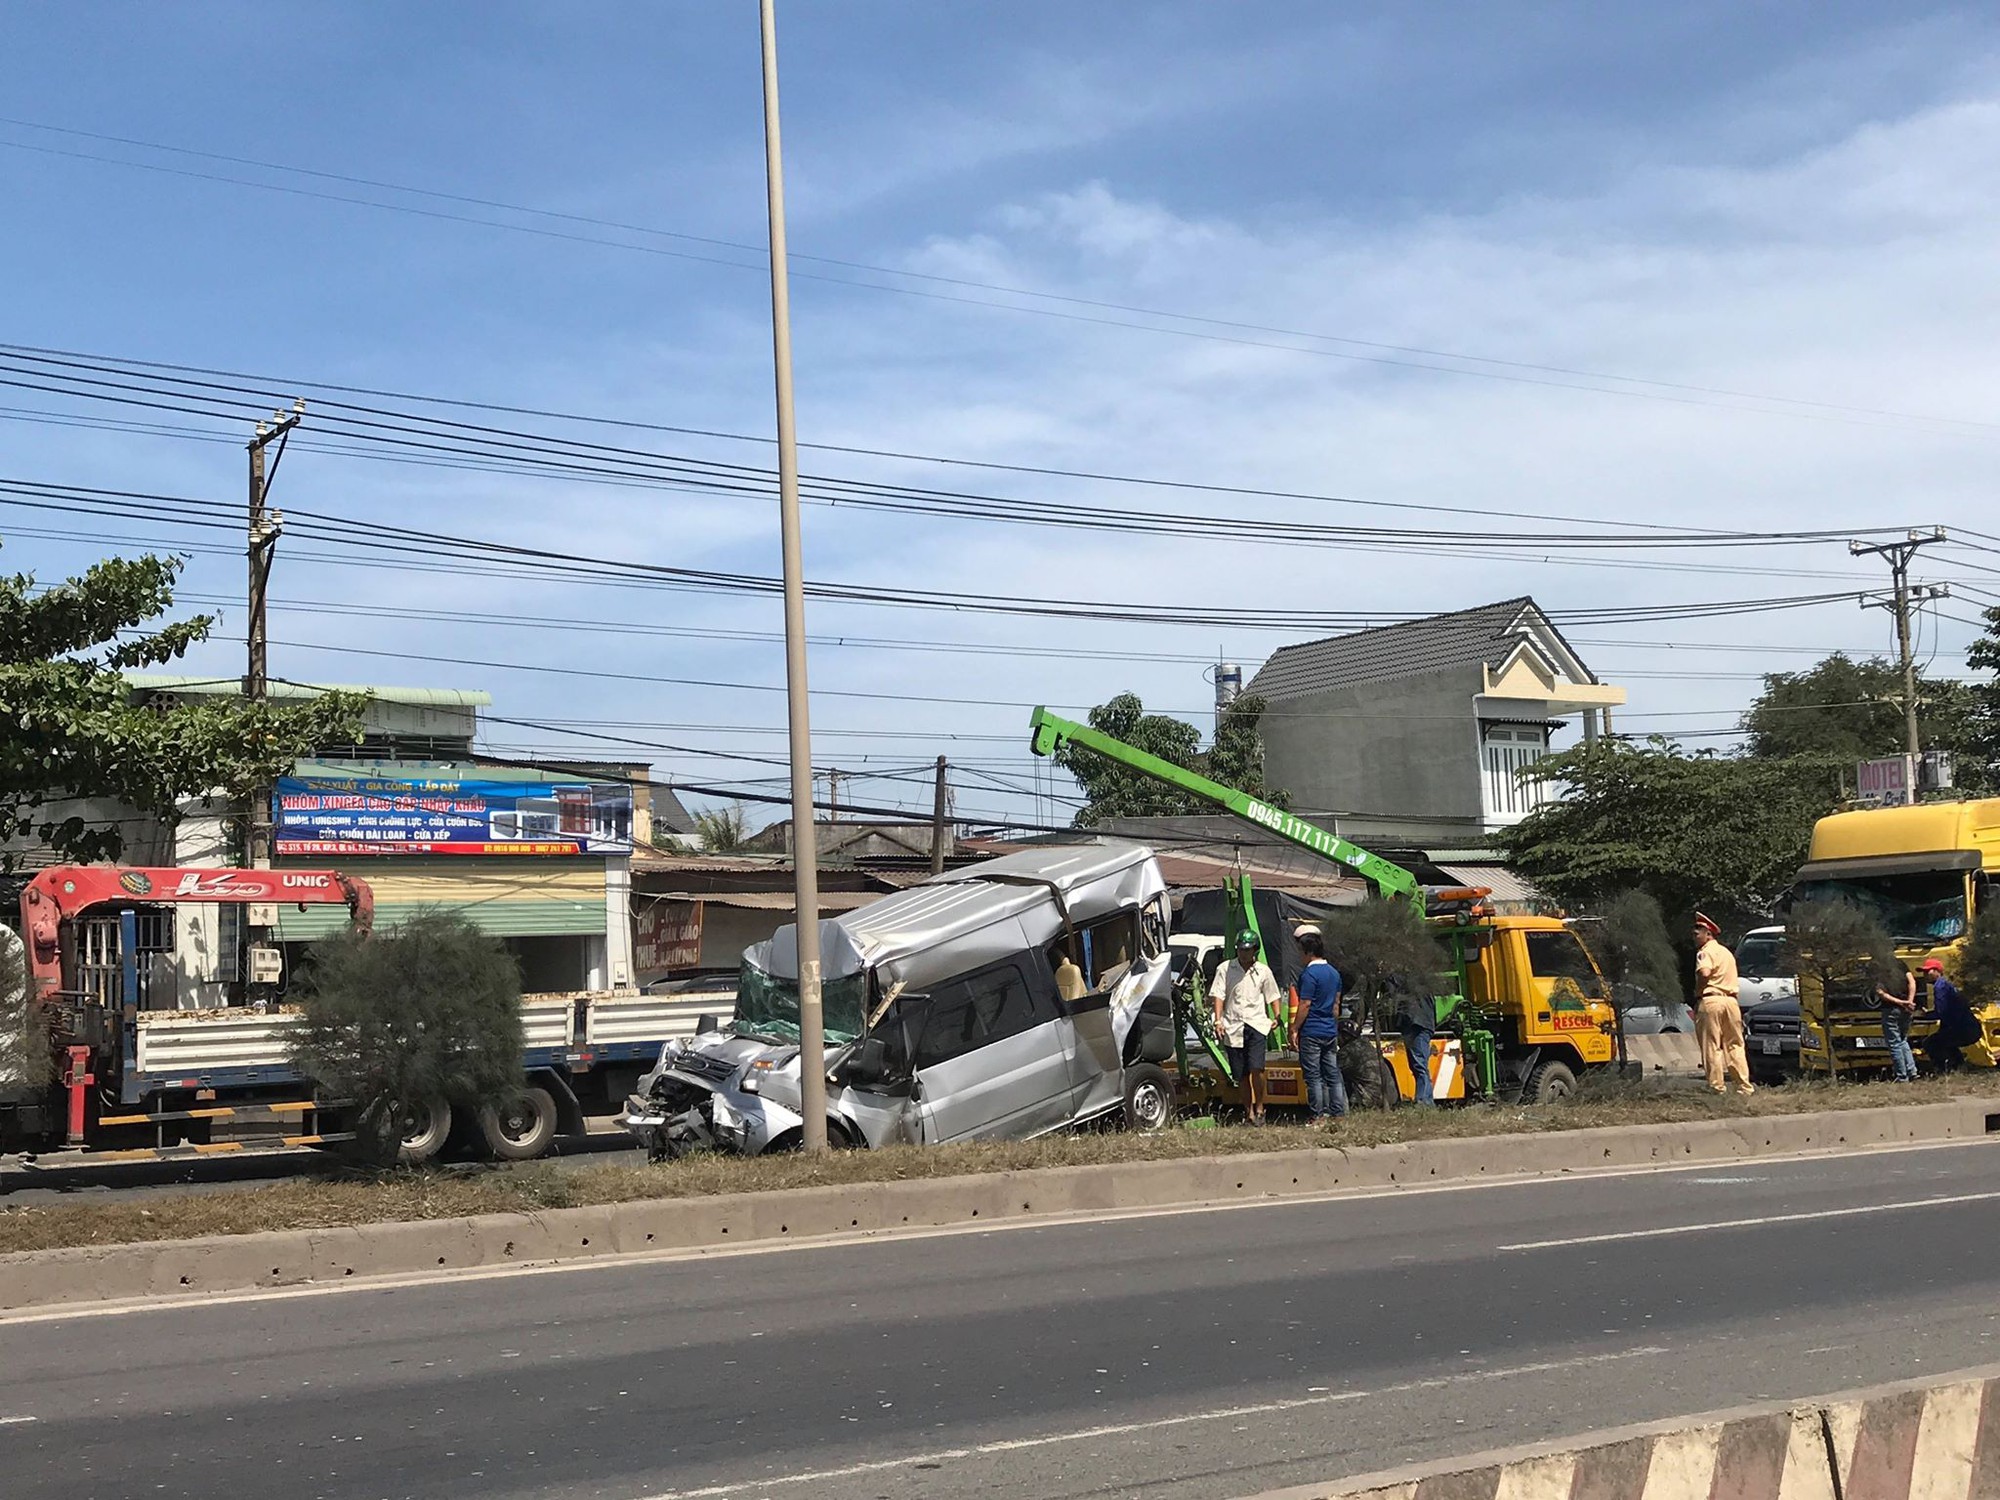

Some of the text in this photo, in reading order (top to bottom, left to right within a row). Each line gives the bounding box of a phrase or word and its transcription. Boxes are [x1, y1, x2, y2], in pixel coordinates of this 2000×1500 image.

[1860, 761, 1905, 790] MOTEL
[366, 781, 383, 791] GIA
[385, 779, 412, 792] CÔNG
[282, 793, 319, 810] NHÔM
[367, 795, 392, 811] CAO
[284, 814, 309, 825] NHÔM
[383, 830, 406, 840] LOAN
[413, 828, 432, 840] CỬA
[1246, 801, 1340, 856] 0945.117.117
[282, 874, 330, 888] UNIC
[1268, 1070, 1294, 1079] STOP
